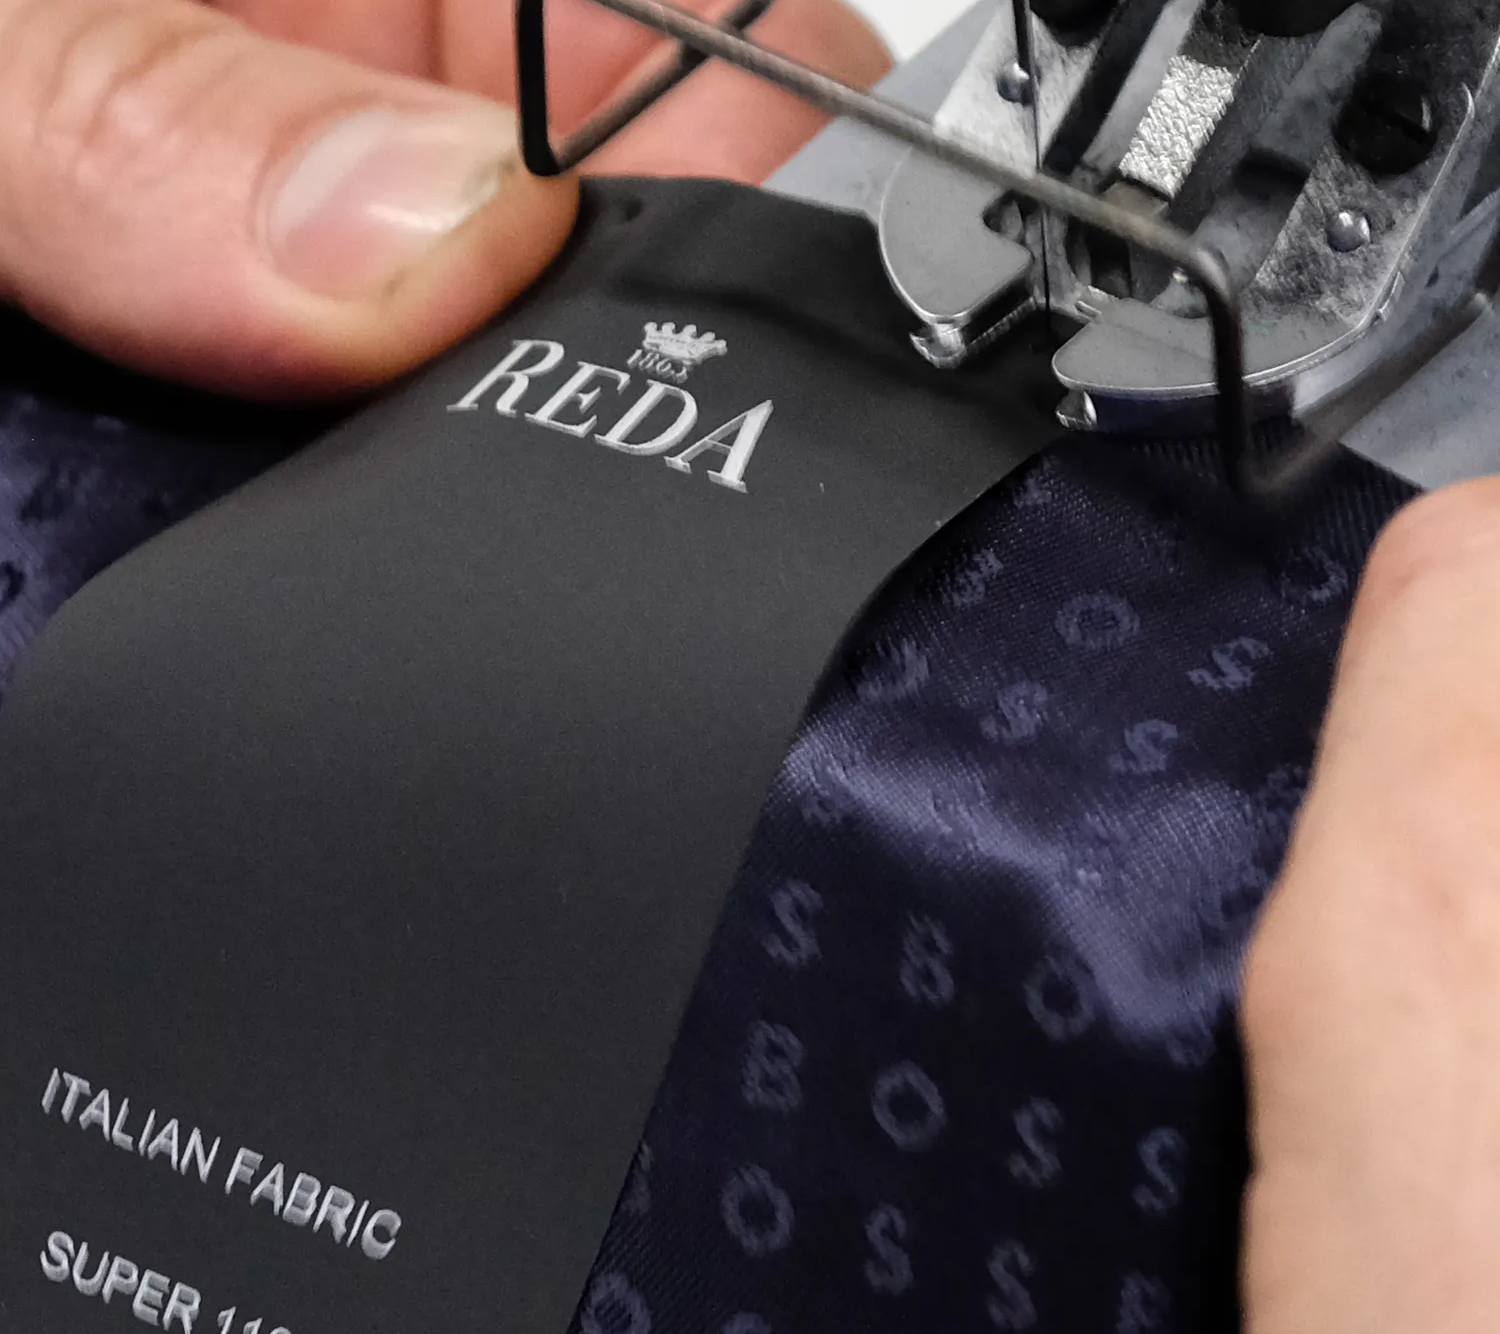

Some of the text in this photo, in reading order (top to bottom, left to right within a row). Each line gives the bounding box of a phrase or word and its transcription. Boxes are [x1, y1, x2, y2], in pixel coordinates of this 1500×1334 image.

[446, 339, 775, 493] REDA
[41, 1068, 401, 1260] ITALIAN FABRIC
